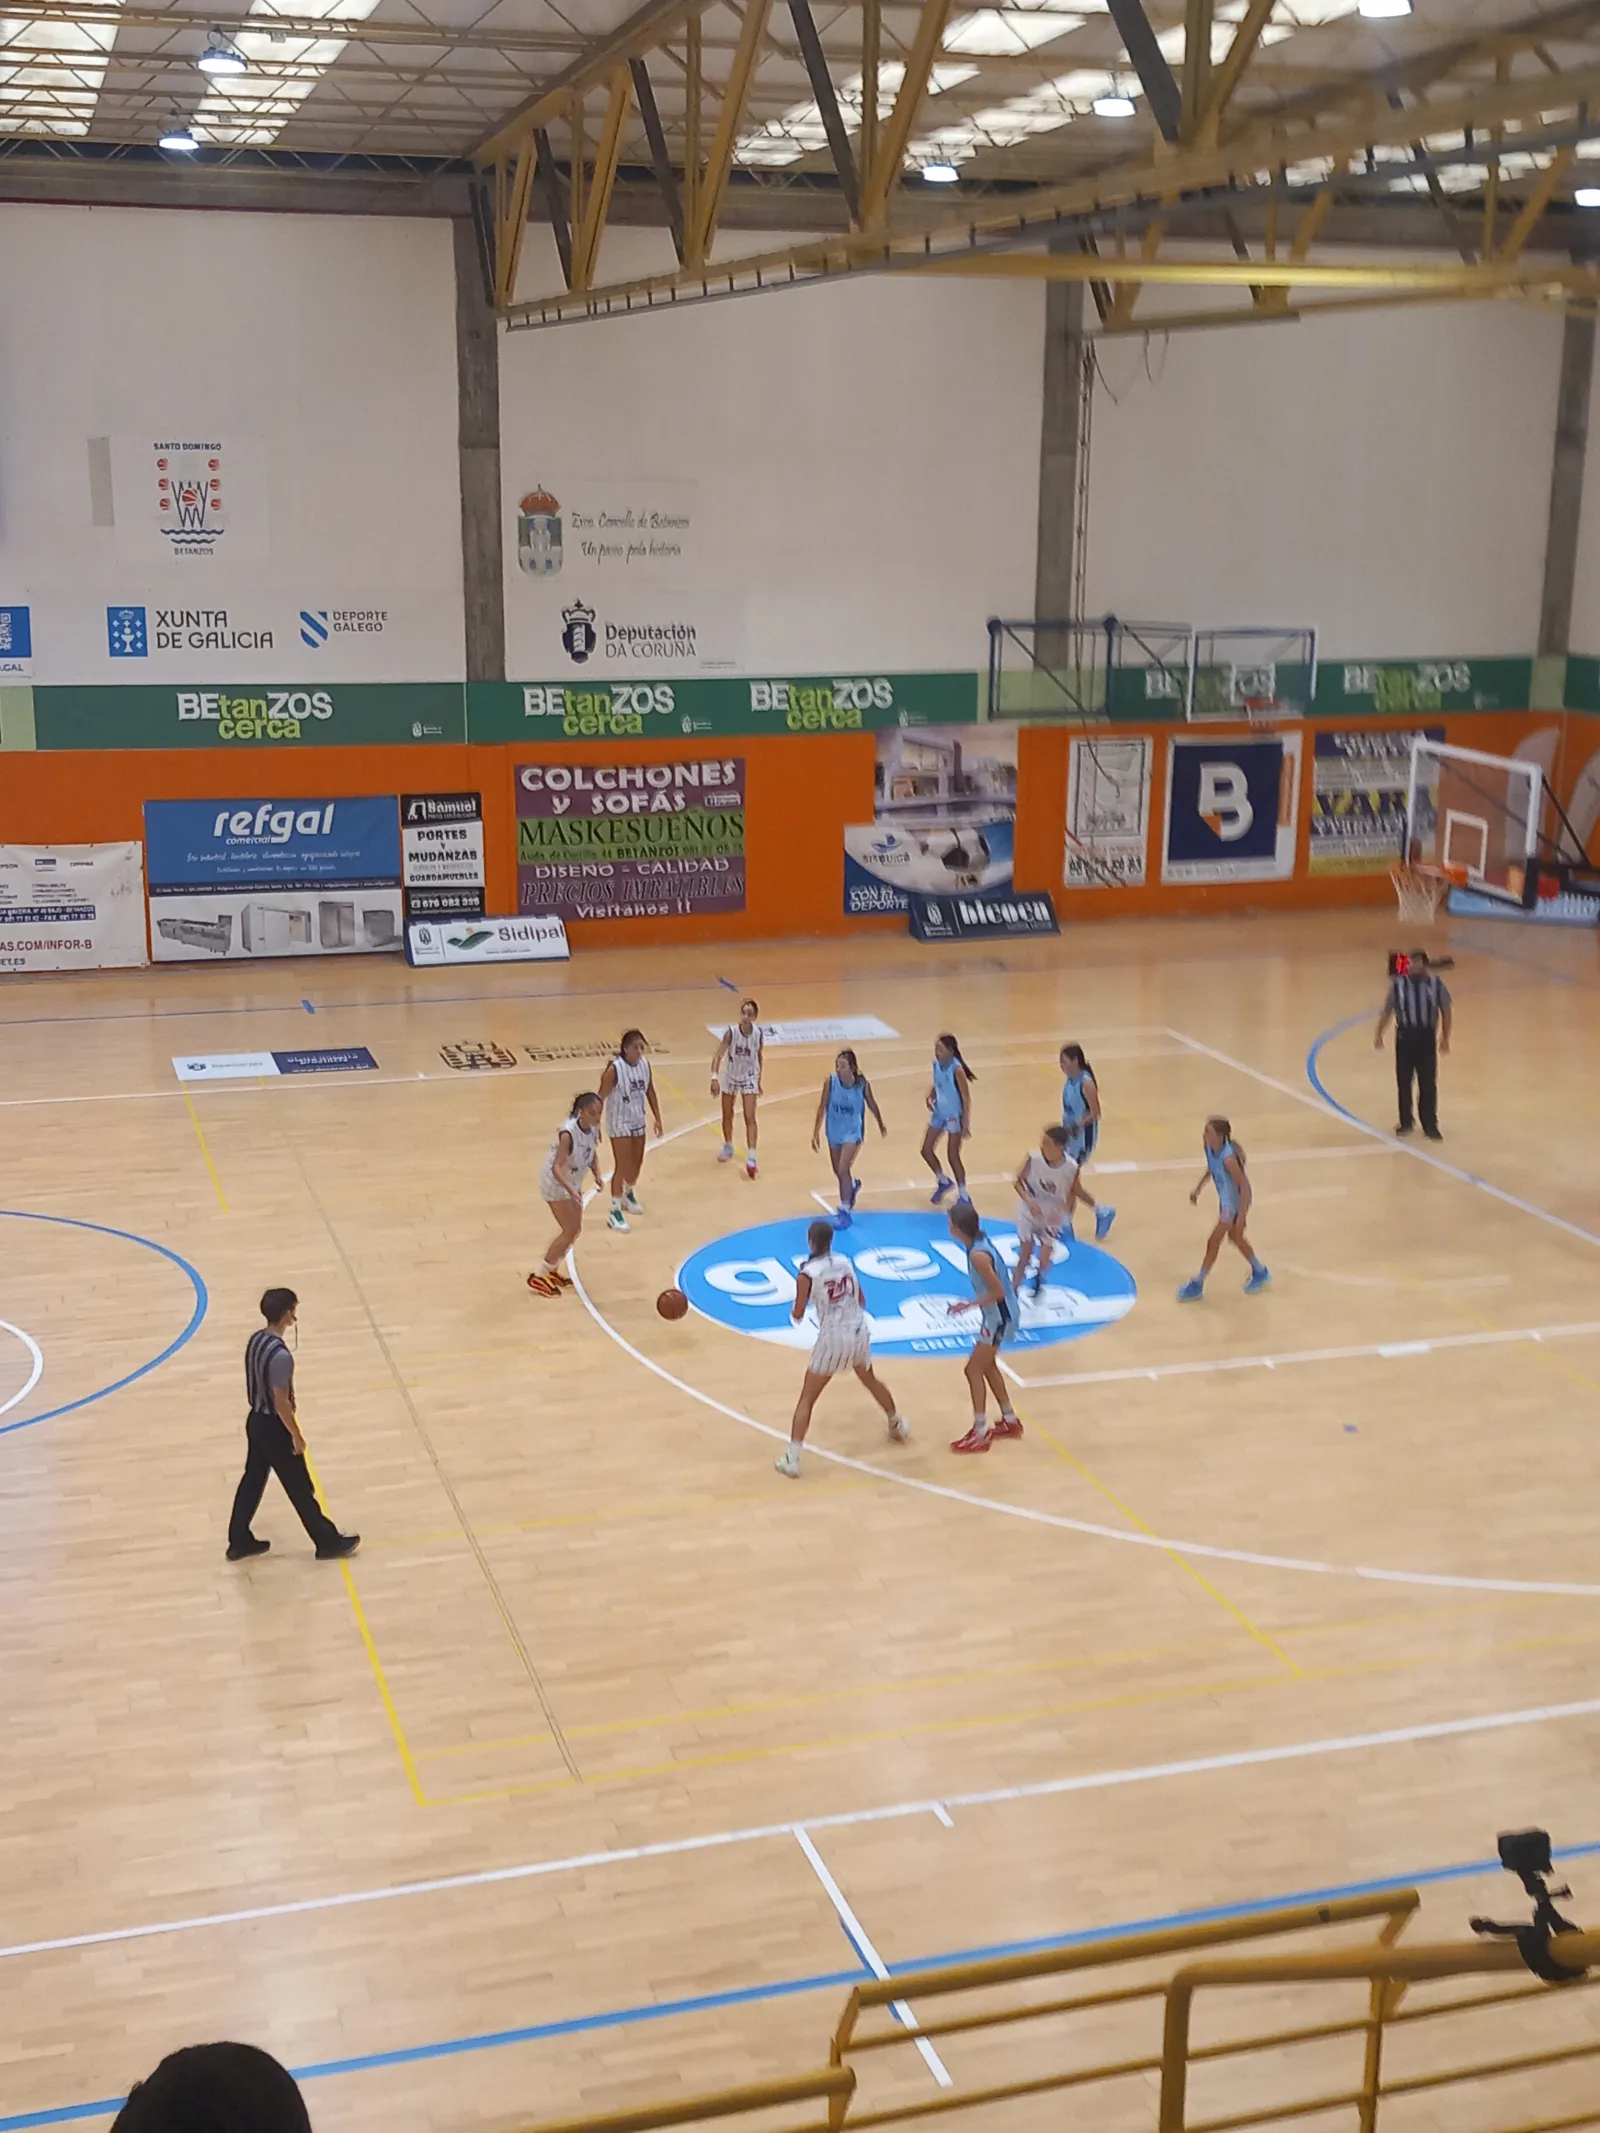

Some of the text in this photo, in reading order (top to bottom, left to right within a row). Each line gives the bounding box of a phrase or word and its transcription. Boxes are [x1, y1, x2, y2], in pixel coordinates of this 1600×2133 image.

[154, 443, 222, 451] SANTO DOMINGO
[156, 610, 228, 628] XUNTA
[333, 611, 388, 621] DEPORTE
[333, 622, 383, 632] GALEGO
[605, 624, 697, 644] Deputación
[156, 632, 274, 649] DE GALICIA
[605, 641, 697, 658] DA CORUÑA
[0, 664, 24, 672] .GAL
[563, 712, 643, 736] cerca
[786, 708, 863, 731] cerca
[218, 717, 301, 740] cerca
[520, 760, 736, 791] COLCHONES
[213, 803, 335, 843] refgal
[226, 835, 271, 845] comercial
[417, 829, 468, 841] PORTES
[408, 850, 478, 862] MUDANZAS
[617, 846, 680, 859] BETANZOS
[637, 857, 729, 876] CALIDAD
[410, 872, 479, 882] GUARDAMUEBLES
[521, 874, 744, 905] PRECIOS IMBATIBLES
[850, 895, 909, 912] DEPORTE
[498, 924, 566, 943] Sidipal
